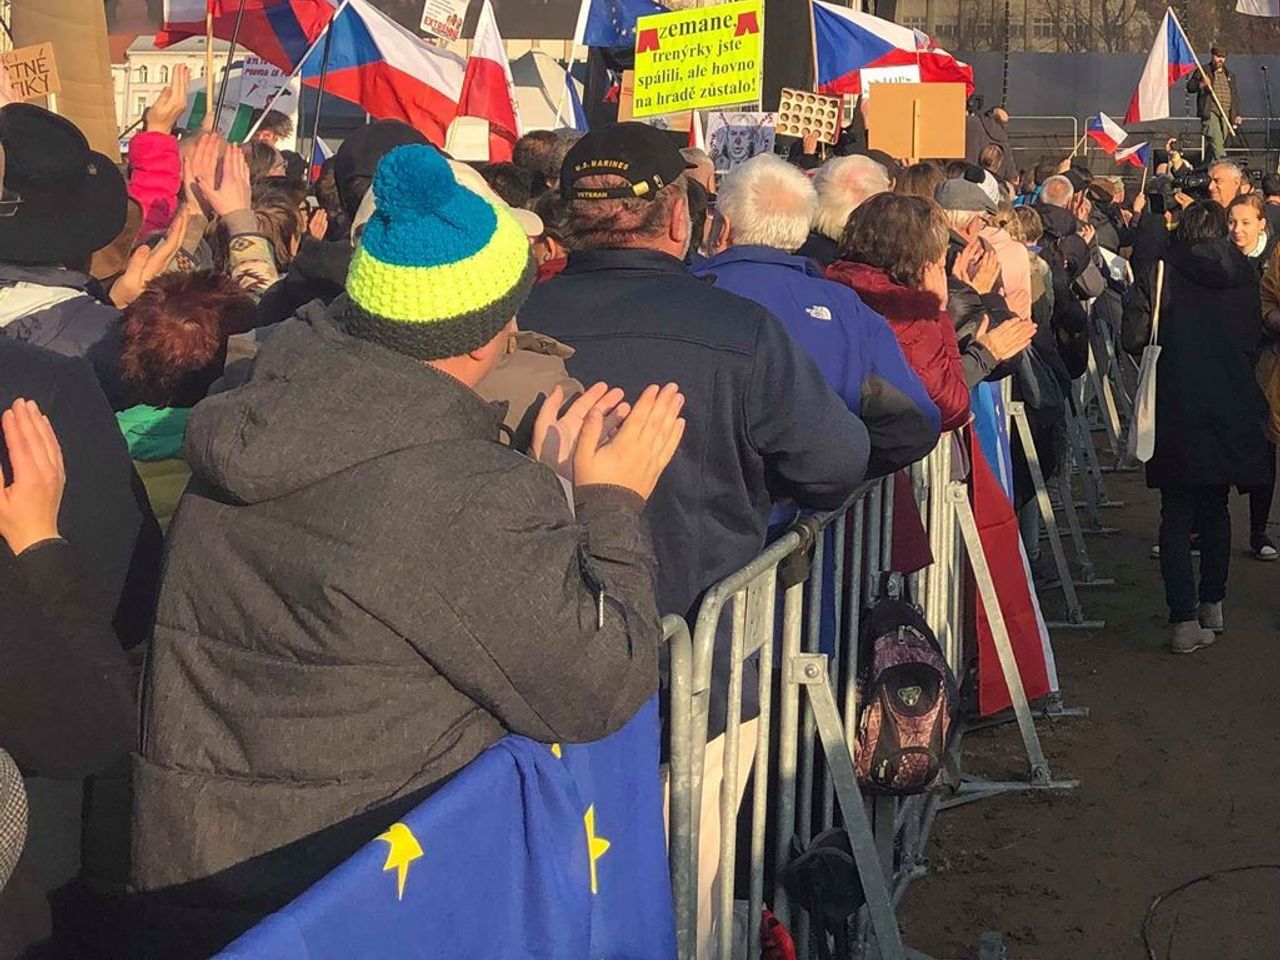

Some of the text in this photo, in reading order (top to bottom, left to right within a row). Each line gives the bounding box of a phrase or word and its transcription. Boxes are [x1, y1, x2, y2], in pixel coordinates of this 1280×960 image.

[652, 39, 742, 63] trenýrky jste
[687, 64, 708, 79] ale
[712, 59, 755, 75] hovno
[635, 77, 756, 109] na hradě zůstalo!
